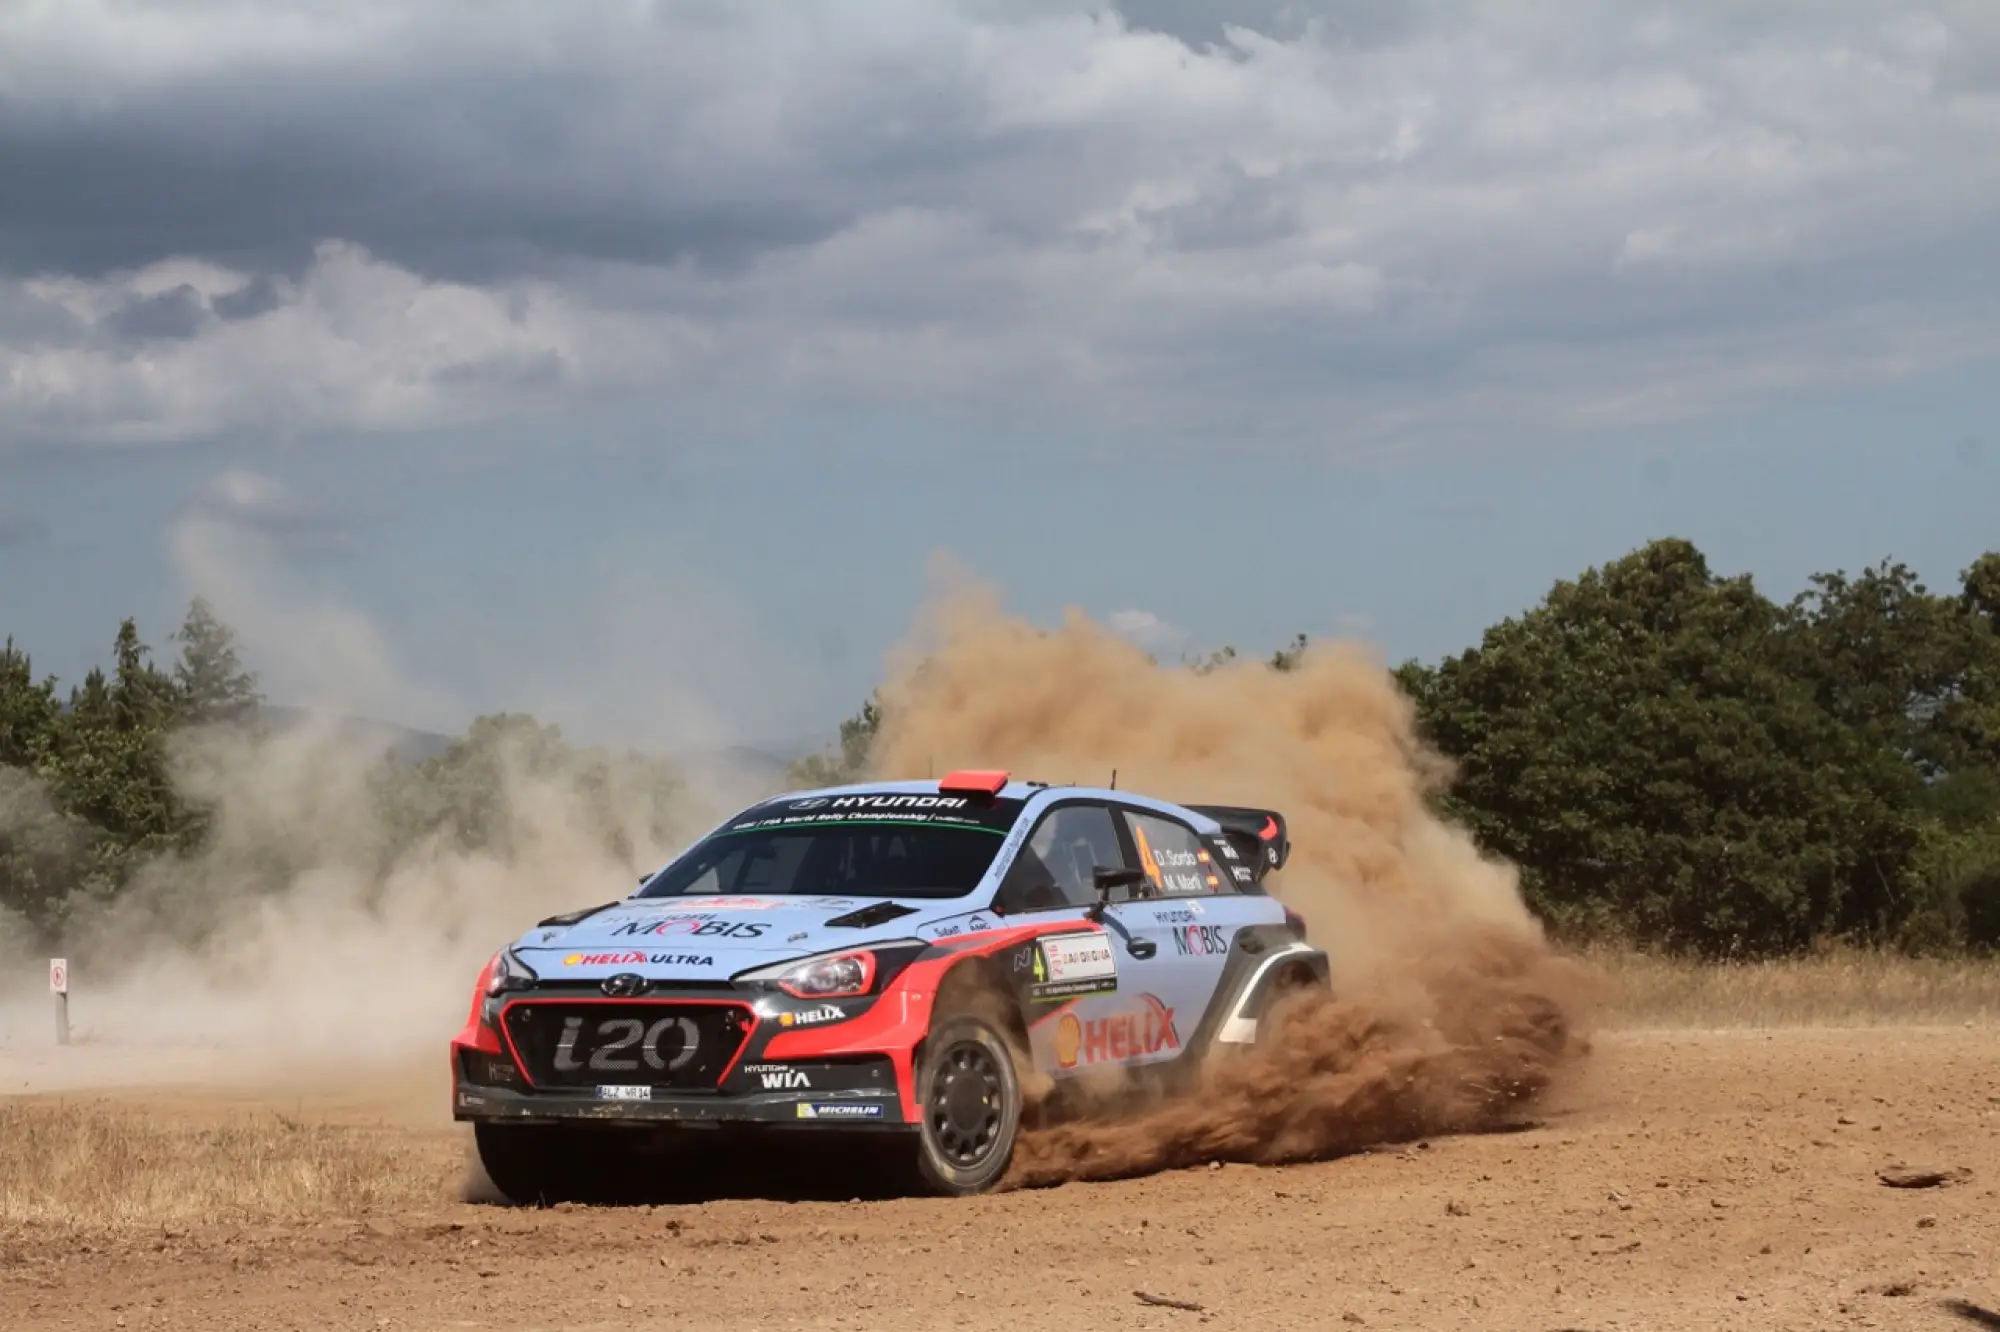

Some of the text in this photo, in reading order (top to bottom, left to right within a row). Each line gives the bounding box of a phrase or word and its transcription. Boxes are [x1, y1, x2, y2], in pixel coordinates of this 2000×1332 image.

[832, 796, 968, 809] HYUNDAI
[784, 813, 816, 824] World
[816, 814, 846, 824] Rally
[848, 812, 928, 822] Championship
[1135, 824, 1163, 889] 4
[1166, 848, 1197, 867] Sordo
[609, 921, 772, 938] MOBIS
[1172, 924, 1228, 957] MOBIS
[582, 951, 714, 966] HELIX ULTRA
[1033, 946, 1045, 984] 4
[795, 1004, 847, 1025] HELIX
[1084, 993, 1181, 1064] HELIX
[553, 1017, 700, 1070] i20
[744, 1065, 789, 1073] HYUNDAI
[818, 1105, 879, 1115] MICHELIN
